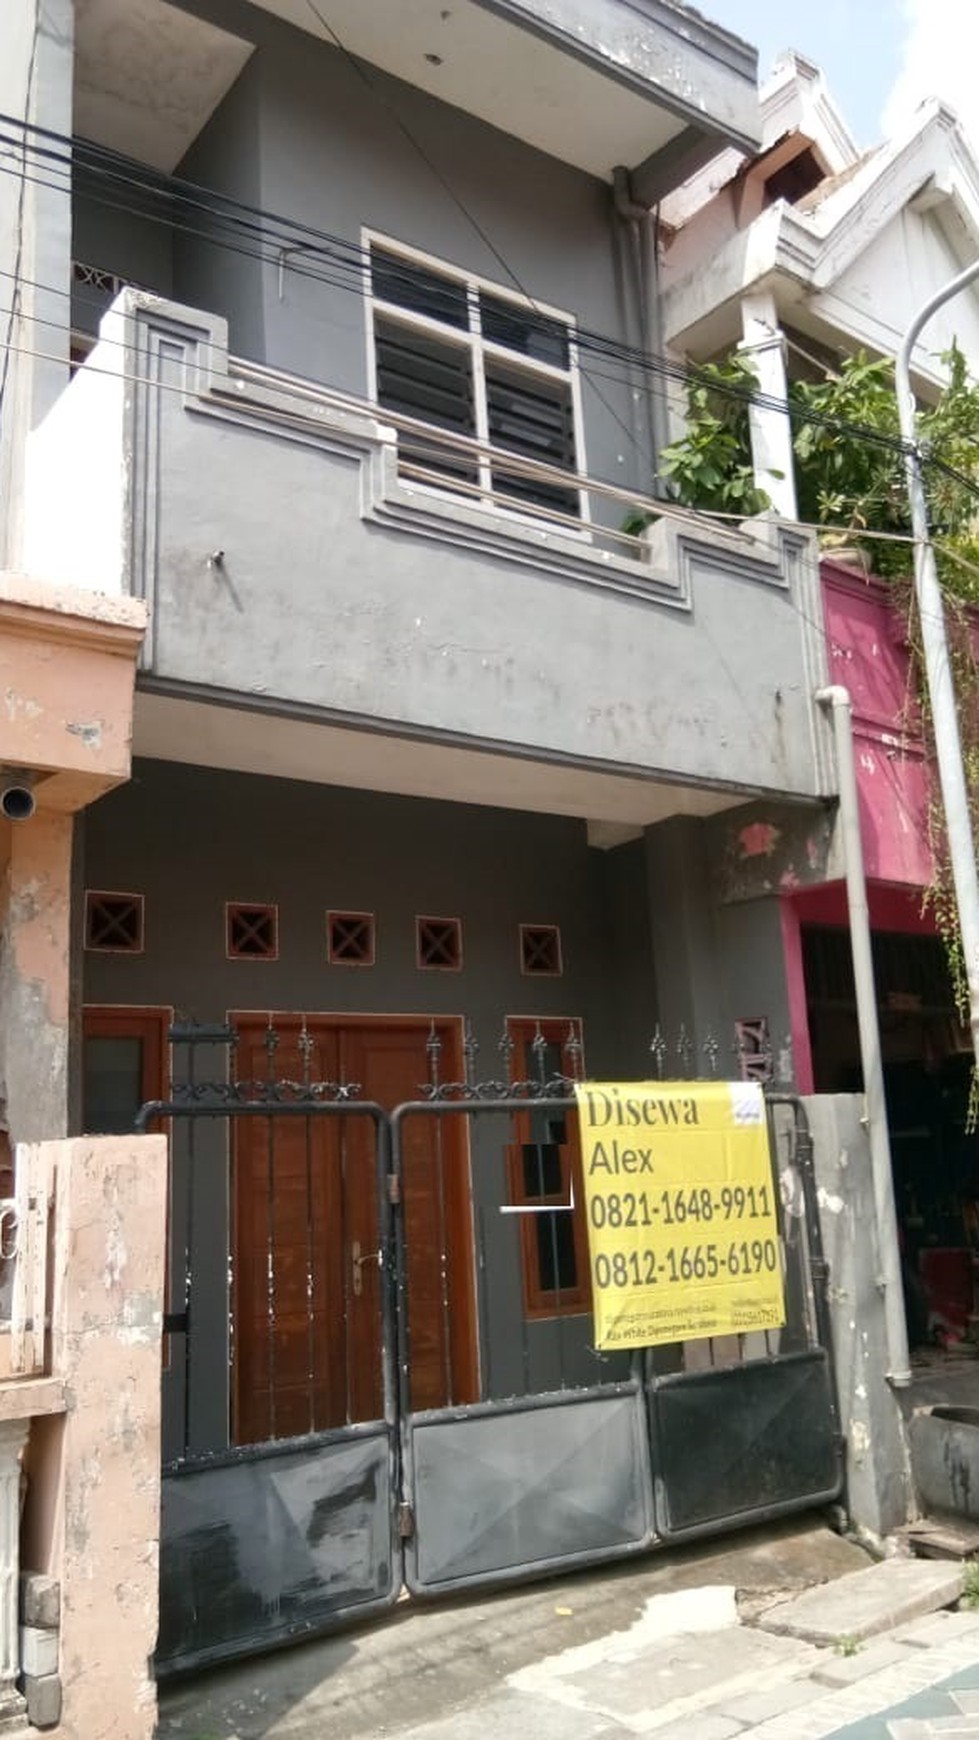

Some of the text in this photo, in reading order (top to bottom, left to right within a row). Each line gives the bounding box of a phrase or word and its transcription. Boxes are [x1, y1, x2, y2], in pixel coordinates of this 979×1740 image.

[585, 1088, 699, 1127] Disewa
[588, 1140, 654, 1176] Alex
[590, 1185, 772, 1228] 0821-1648-9911
[594, 1238, 777, 1289] 0812-1665-6190
